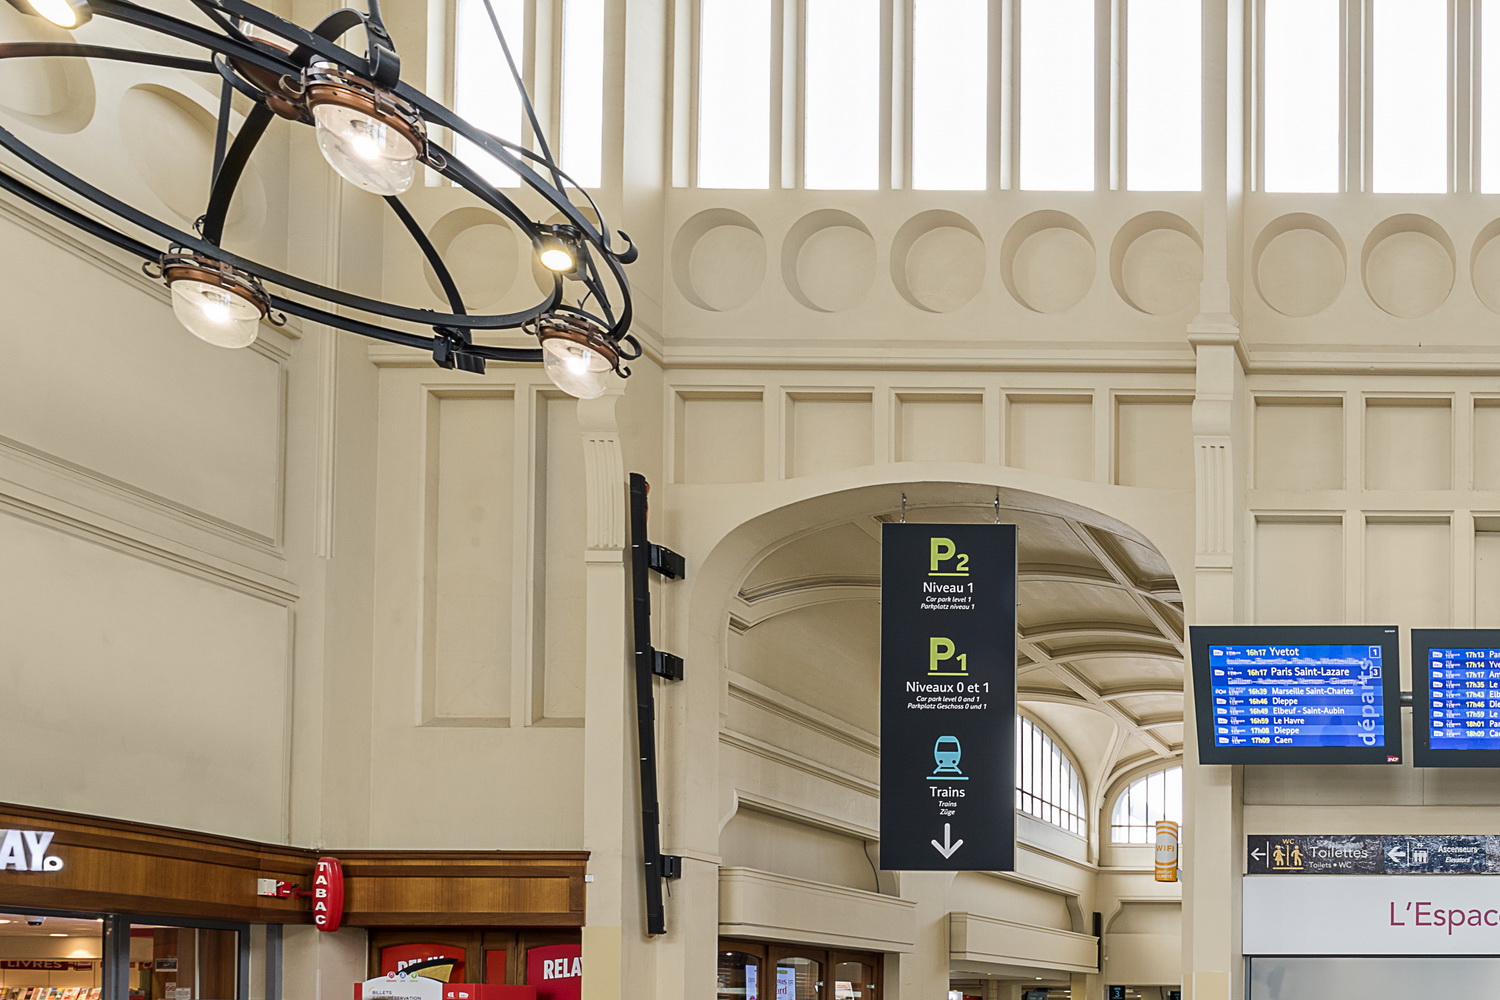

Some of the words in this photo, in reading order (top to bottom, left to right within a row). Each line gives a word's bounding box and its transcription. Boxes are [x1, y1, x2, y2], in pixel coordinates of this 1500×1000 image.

[923, 582, 964, 593] Niveau
[968, 582, 973, 593] 1
[1269, 647, 1299, 656] Yvetot
[1271, 667, 1292, 676] Paris
[1294, 667, 1350, 676] Saint-Lazare
[906, 682, 953, 692] Niveaux
[957, 682, 964, 692] 0
[968, 683, 980, 693] et
[983, 682, 989, 693] 1
[1271, 687, 1304, 695] Marseille
[1305, 687, 1354, 695] Saint-Charles
[1272, 697, 1298, 706] Dieppe
[1358, 658, 1379, 745] départs
[1274, 726, 1300, 735] Dieppe
[1274, 736, 1293, 744] Caen
[930, 787, 965, 797] Trains
[1310, 846, 1369, 858] Toilettes
[1438, 845, 1478, 853] Ascenseurs
[315, 861, 328, 925] TABAC
[8, 960, 62, 968] LIVRES
[544, 957, 582, 979] RELA
